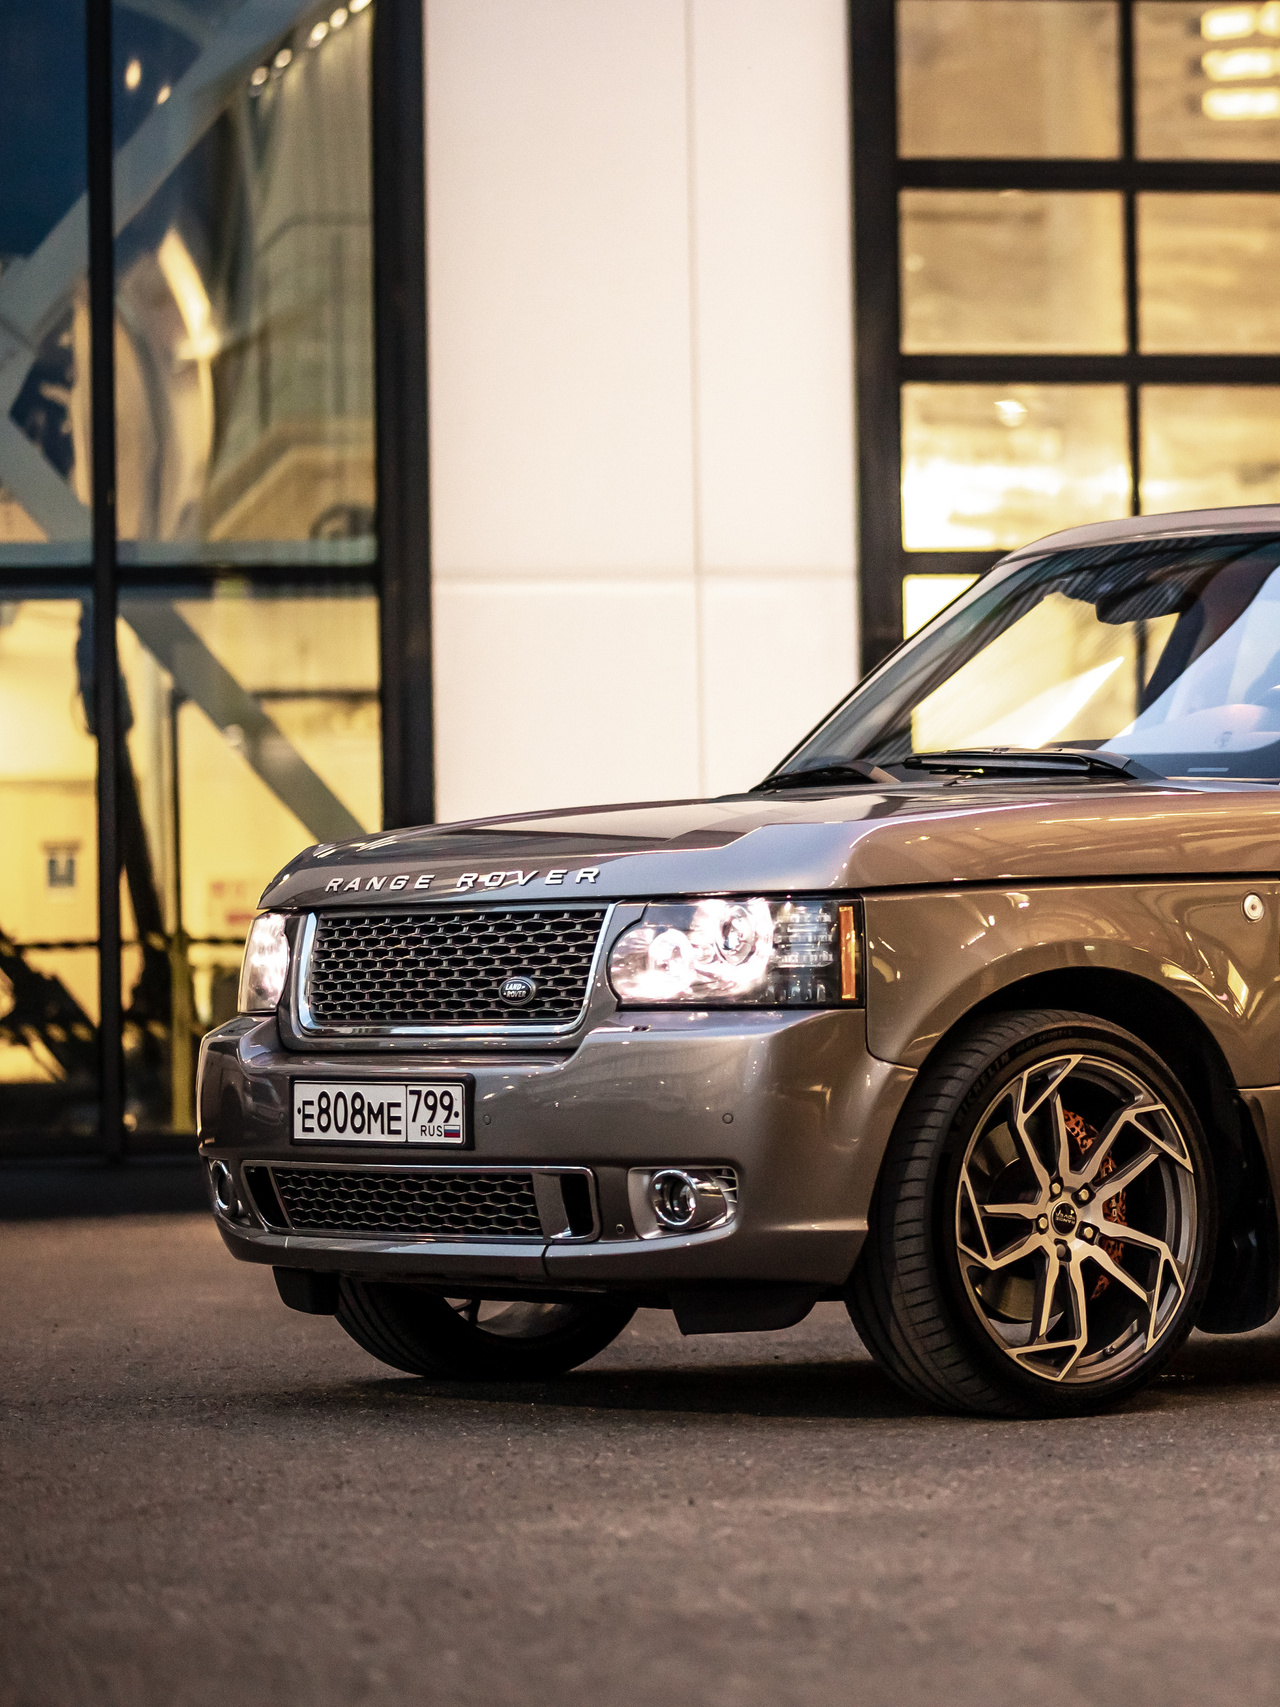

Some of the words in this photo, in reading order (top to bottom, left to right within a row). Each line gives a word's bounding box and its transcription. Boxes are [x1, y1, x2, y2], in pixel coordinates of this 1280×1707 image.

[325, 874, 435, 892] RANGE
[456, 867, 600, 888] ROVER
[302, 1090, 402, 1135] E808ME
[408, 1089, 454, 1124] 799
[420, 1124, 443, 1137] RUS
